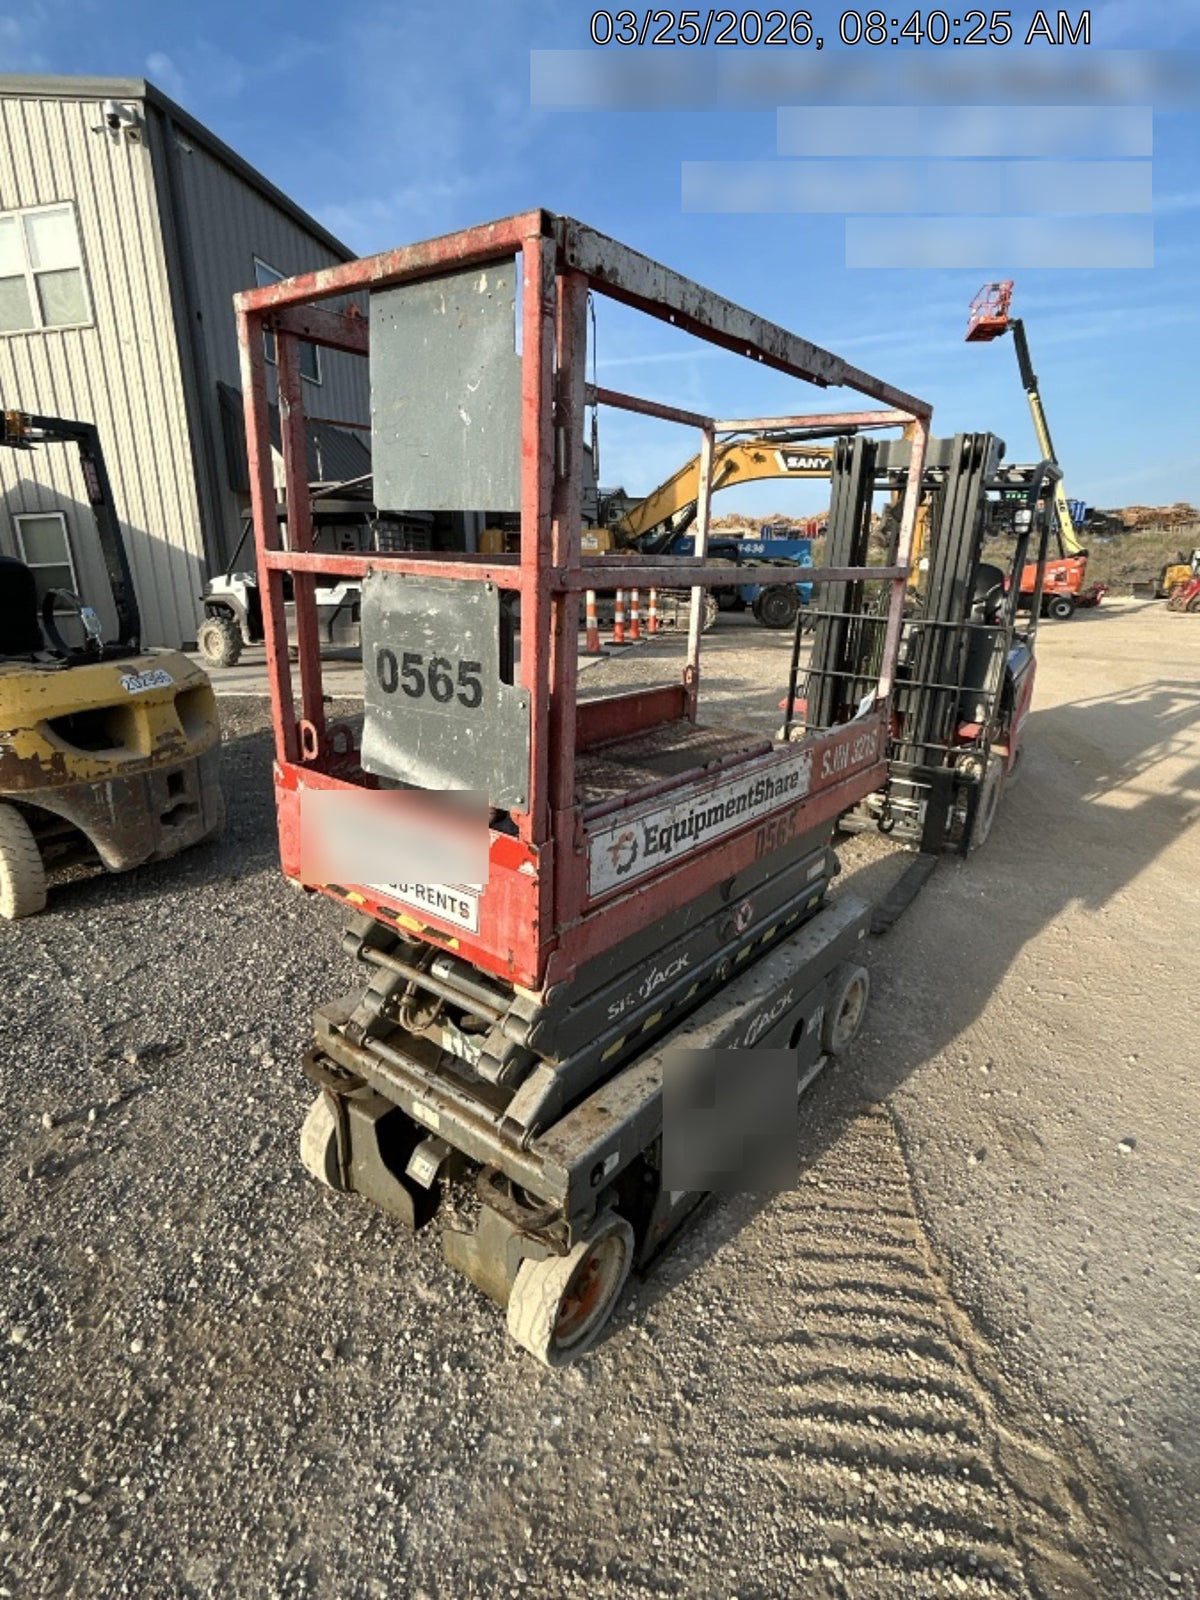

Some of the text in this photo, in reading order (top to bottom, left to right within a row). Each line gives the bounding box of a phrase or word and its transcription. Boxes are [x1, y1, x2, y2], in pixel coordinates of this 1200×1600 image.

[787, 456, 829, 469] SANY
[377, 648, 483, 708] 0565
[642, 770, 800, 858] EquipmentShare
